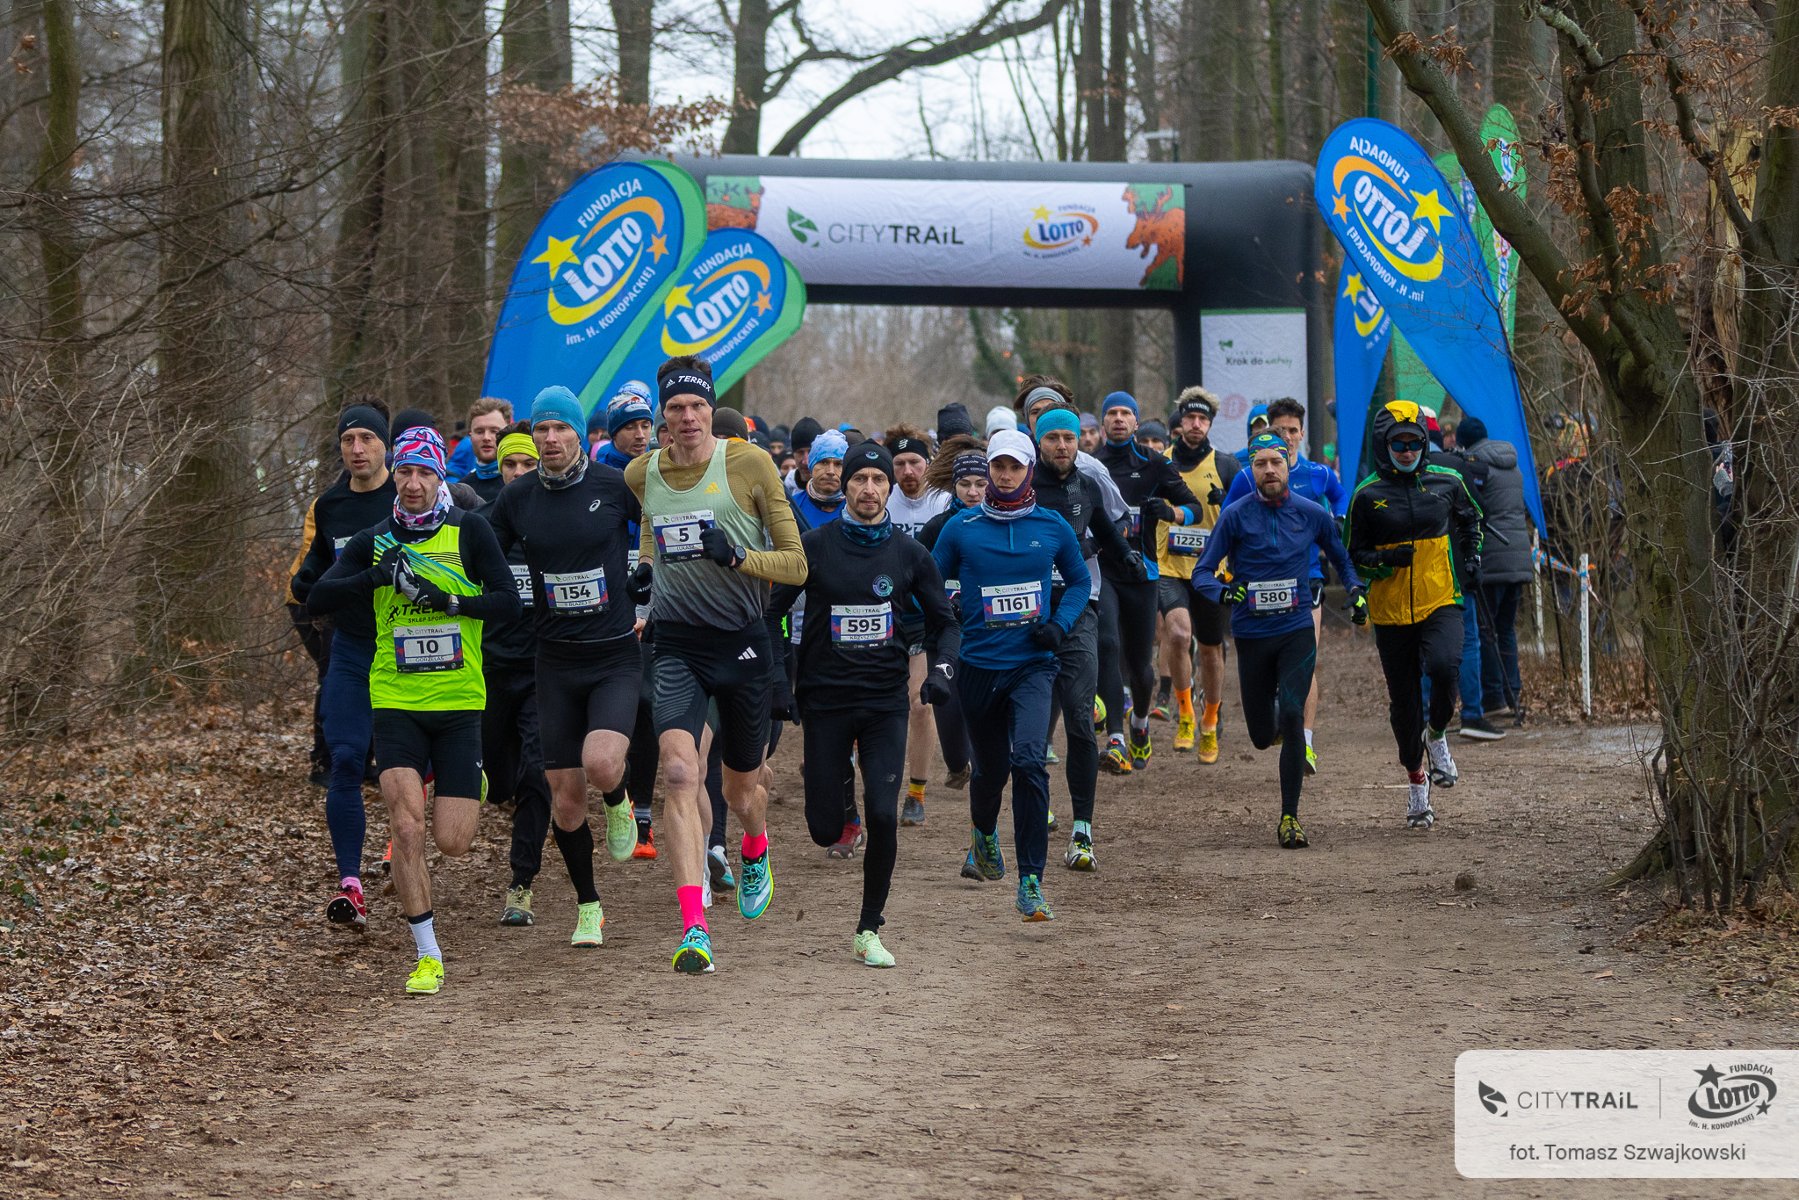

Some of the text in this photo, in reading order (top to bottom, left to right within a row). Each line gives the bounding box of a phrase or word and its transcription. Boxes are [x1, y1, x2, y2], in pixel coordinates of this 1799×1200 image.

[577, 178, 643, 229] FUNDACJA
[1038, 220, 1085, 242] LOTTO
[562, 217, 642, 302] LOTTO
[692, 242, 753, 279] FUNDACJA
[566, 266, 656, 345] im. H. KONOPACKIEJ
[676, 274, 750, 341] LOTTO
[678, 375, 711, 393] TERREX
[679, 527, 690, 542] 5
[1176, 535, 1203, 546] 1225
[560, 584, 591, 600] 154
[1260, 591, 1287, 603] 580
[997, 596, 1030, 612] 1161
[848, 618, 881, 633] 595
[416, 639, 439, 655] 10
